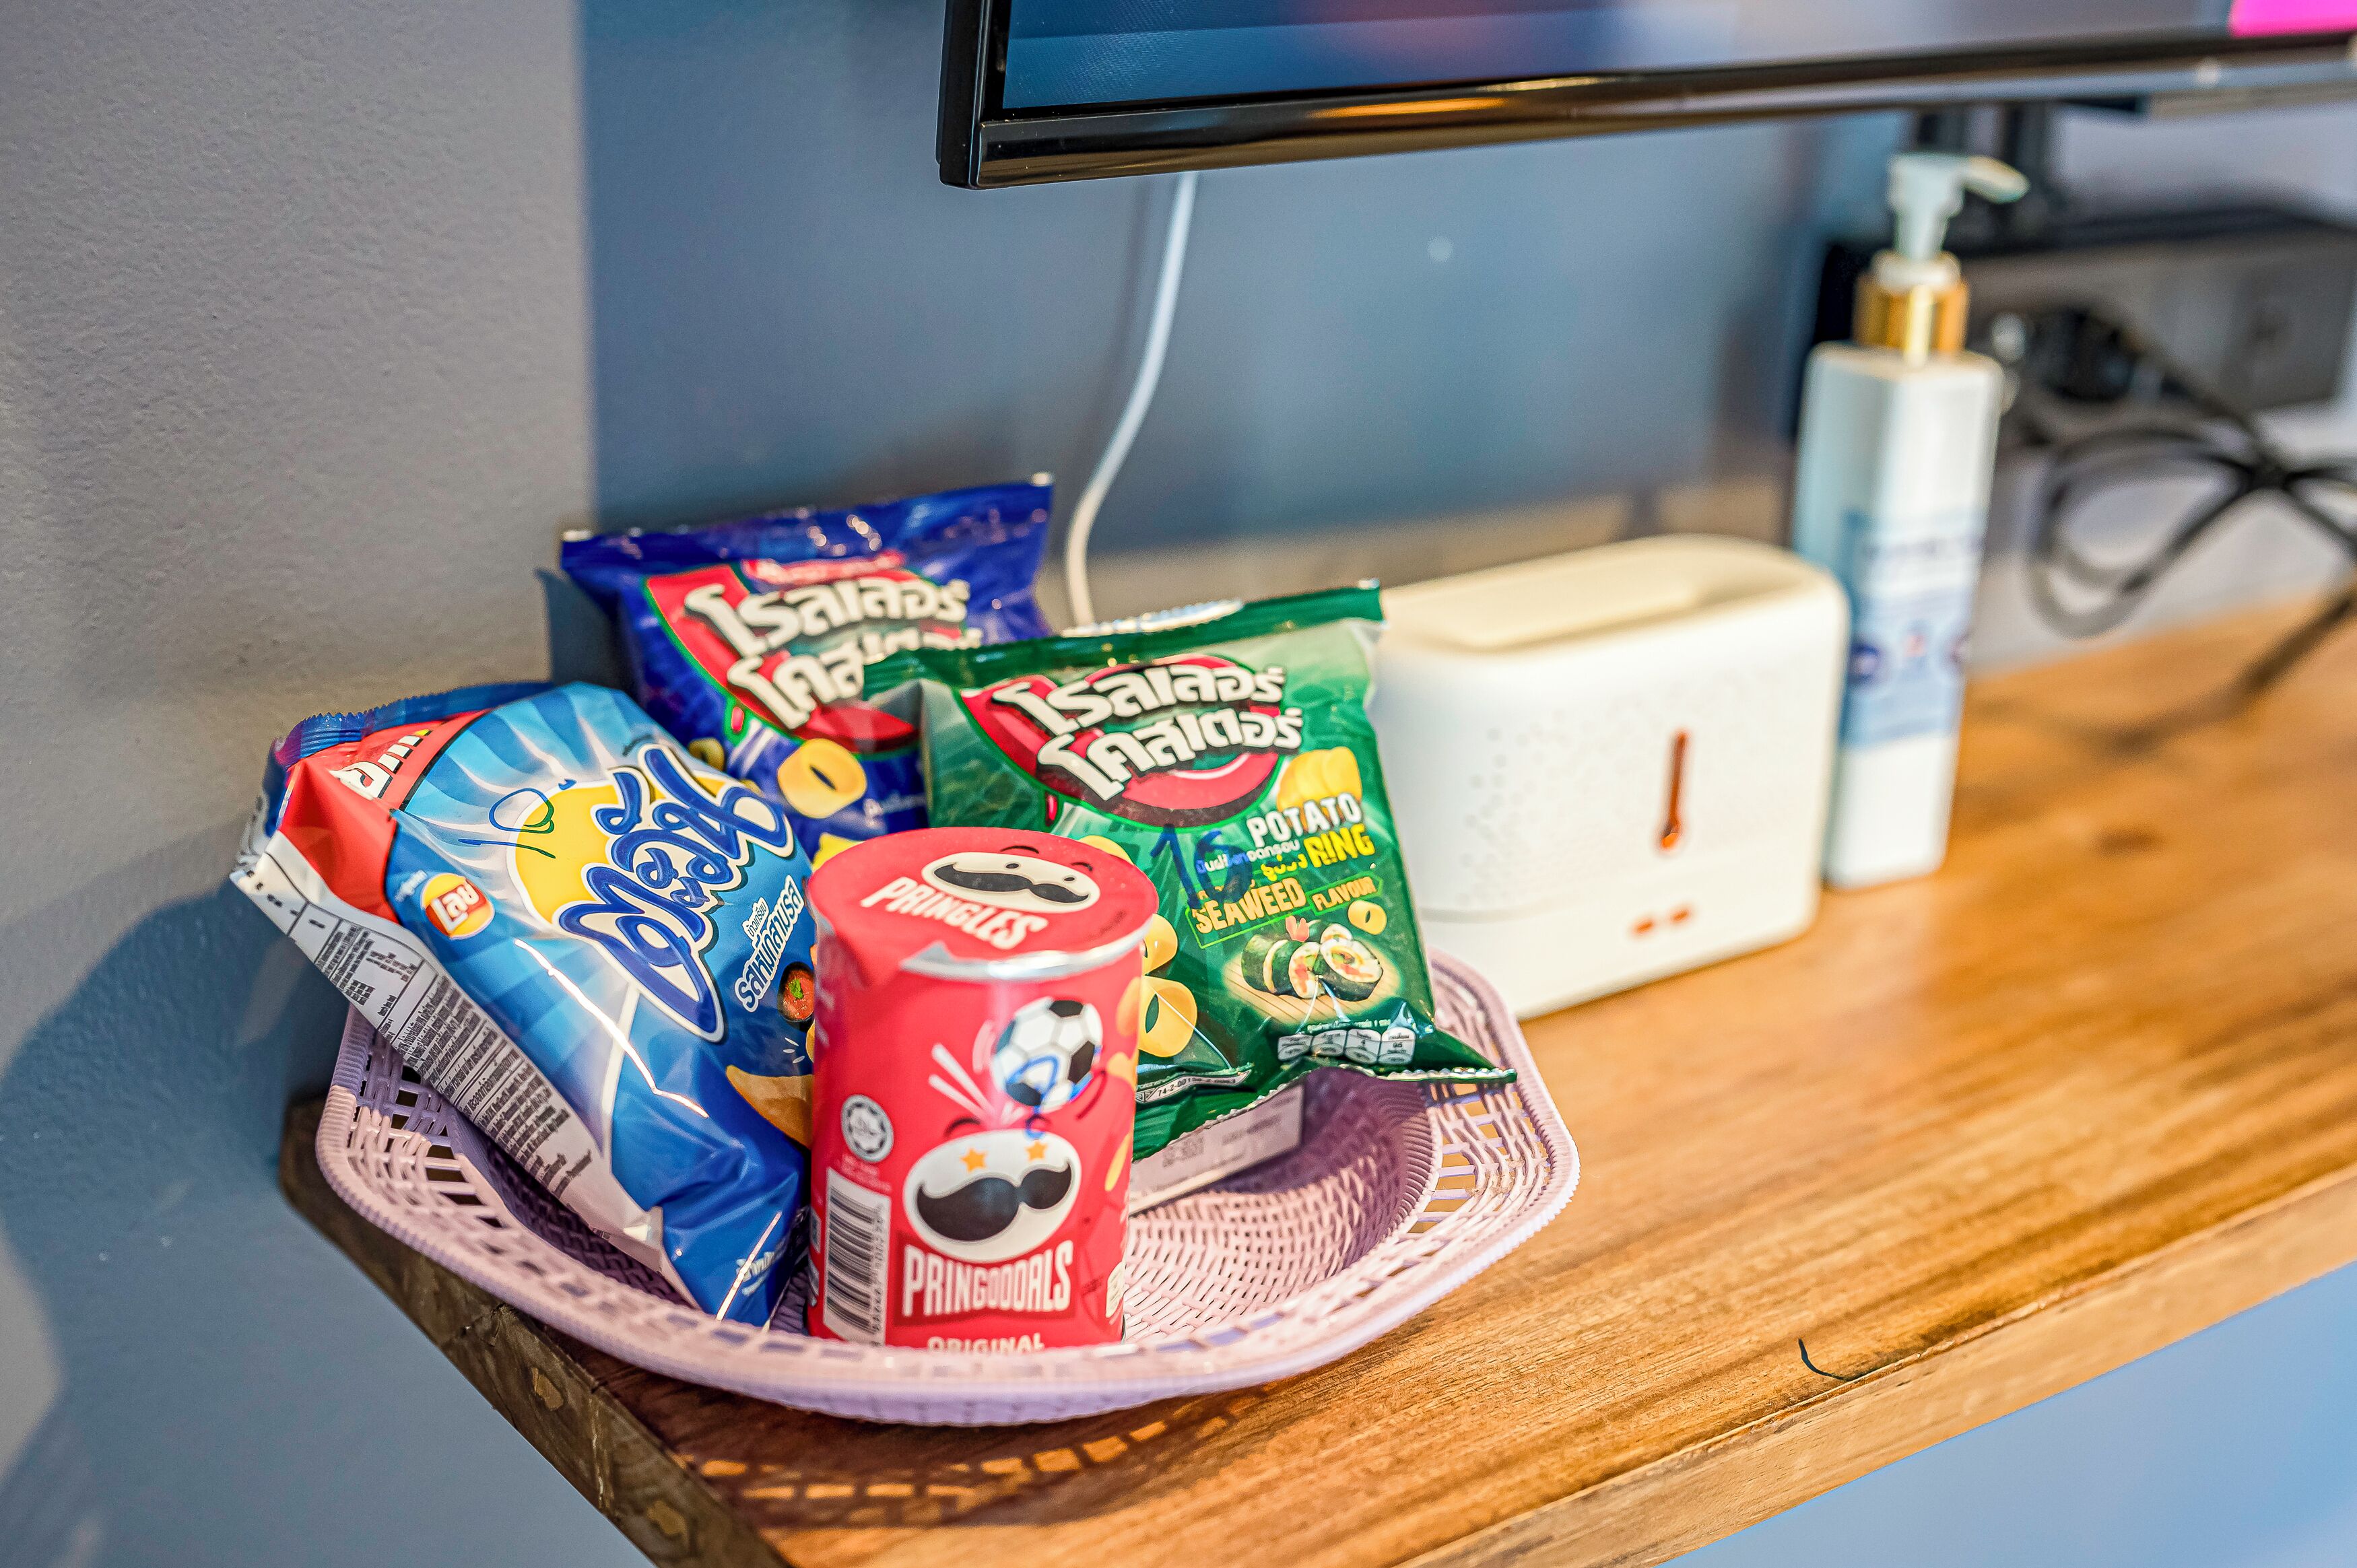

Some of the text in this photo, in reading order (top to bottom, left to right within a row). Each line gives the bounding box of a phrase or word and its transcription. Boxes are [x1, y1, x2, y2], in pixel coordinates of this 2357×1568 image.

[684, 578, 970, 656] โรลเลอร์
[992, 664, 1286, 737] โรลเลอร์
[1038, 707, 1303, 801] โคสเตอร์
[1246, 791, 1362, 848] POTATO
[1302, 822, 1376, 868] RING
[559, 746, 787, 1035] ตะวัน
[859, 876, 1049, 951] PRINGLES
[1191, 877, 1307, 934] SEAWEED
[902, 1239, 1074, 1318] PRINGOOOALS
